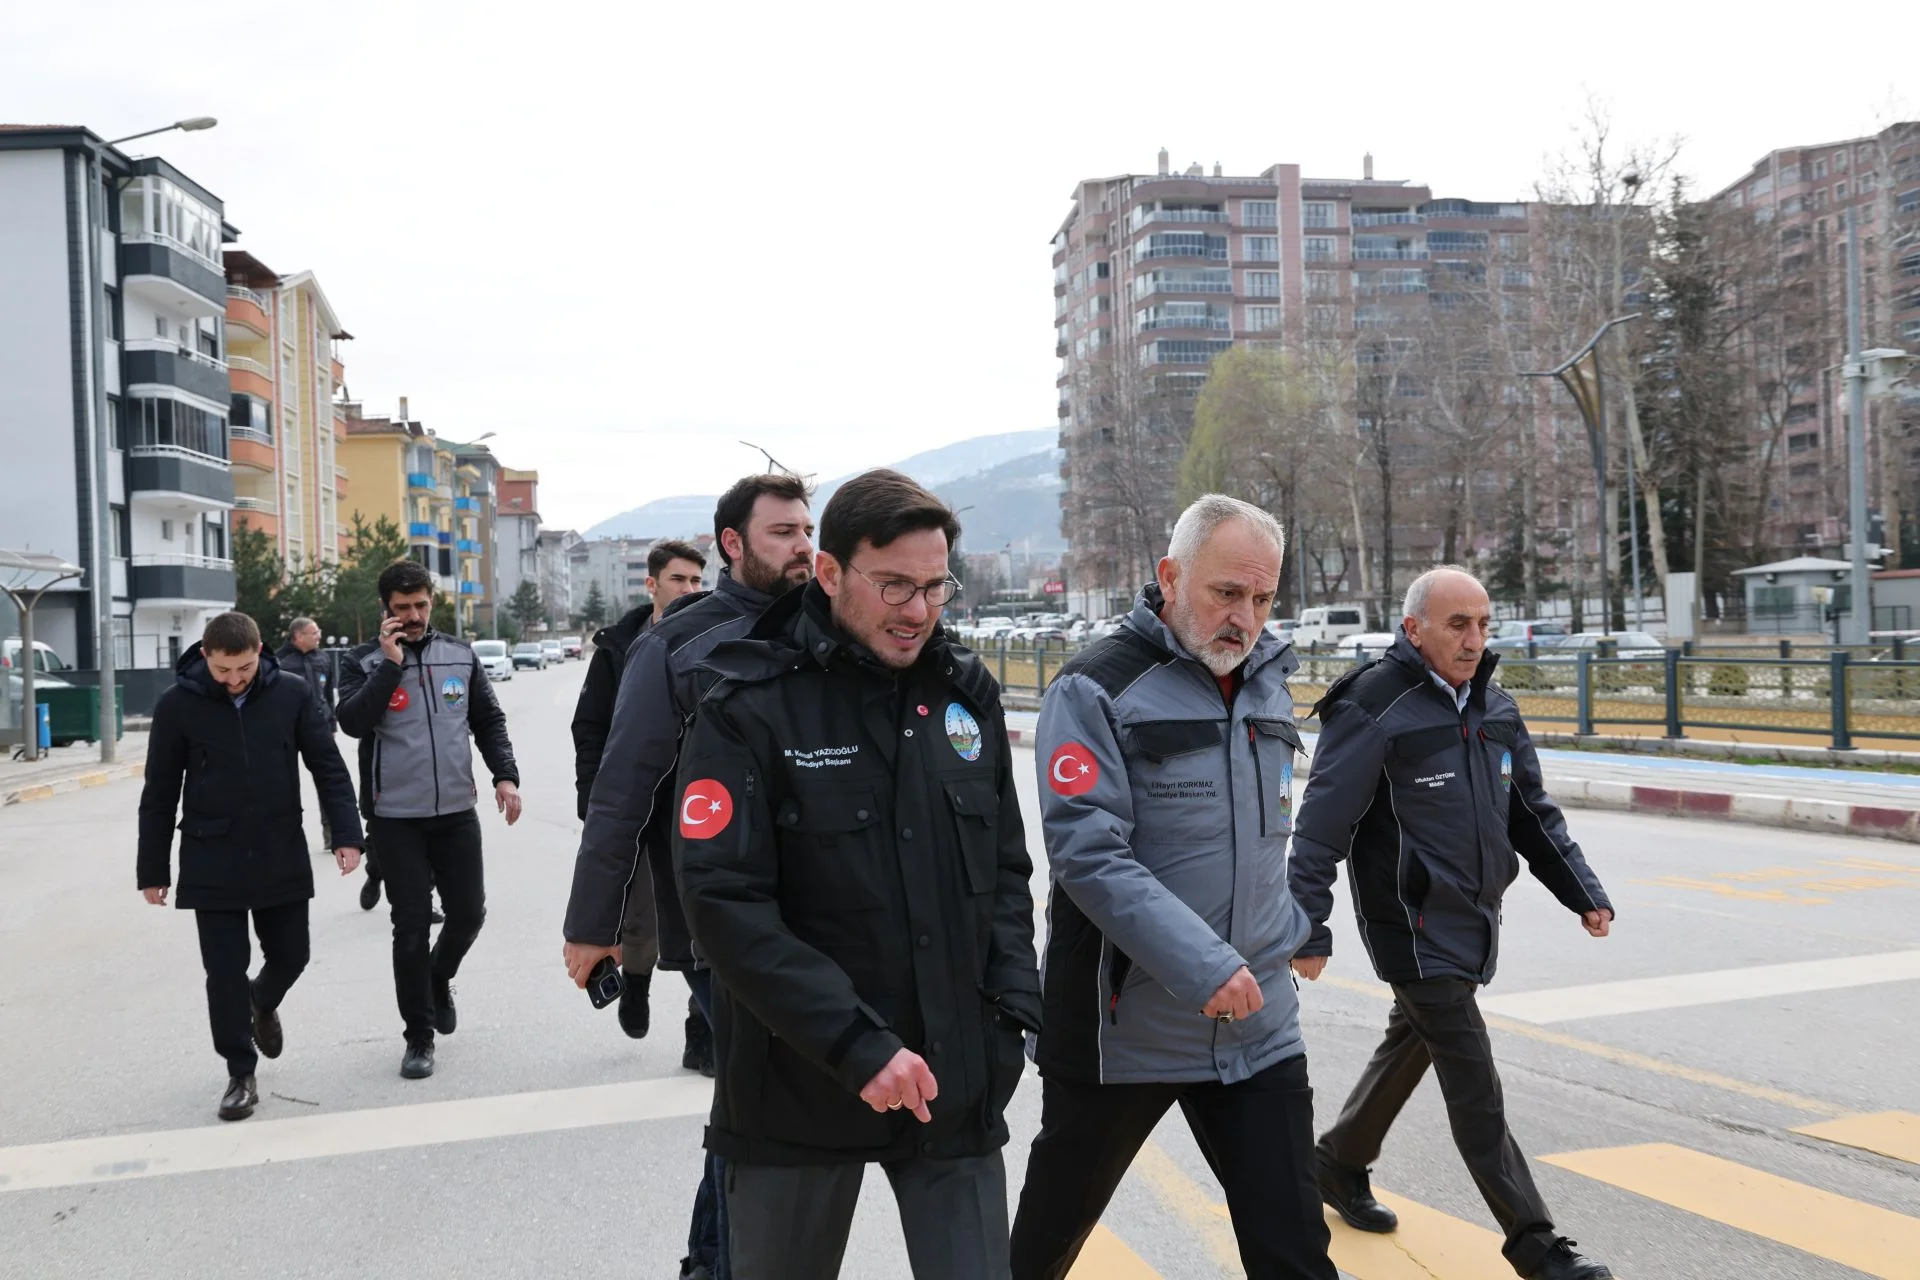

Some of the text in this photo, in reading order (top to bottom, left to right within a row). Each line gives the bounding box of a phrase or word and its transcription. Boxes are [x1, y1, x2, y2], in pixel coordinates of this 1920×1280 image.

[784, 749, 794, 757] M.
[1178, 781, 1213, 789] KORKMAZ
[1179, 791, 1205, 799] Başkan
[1205, 790, 1218, 798] Yrd.
